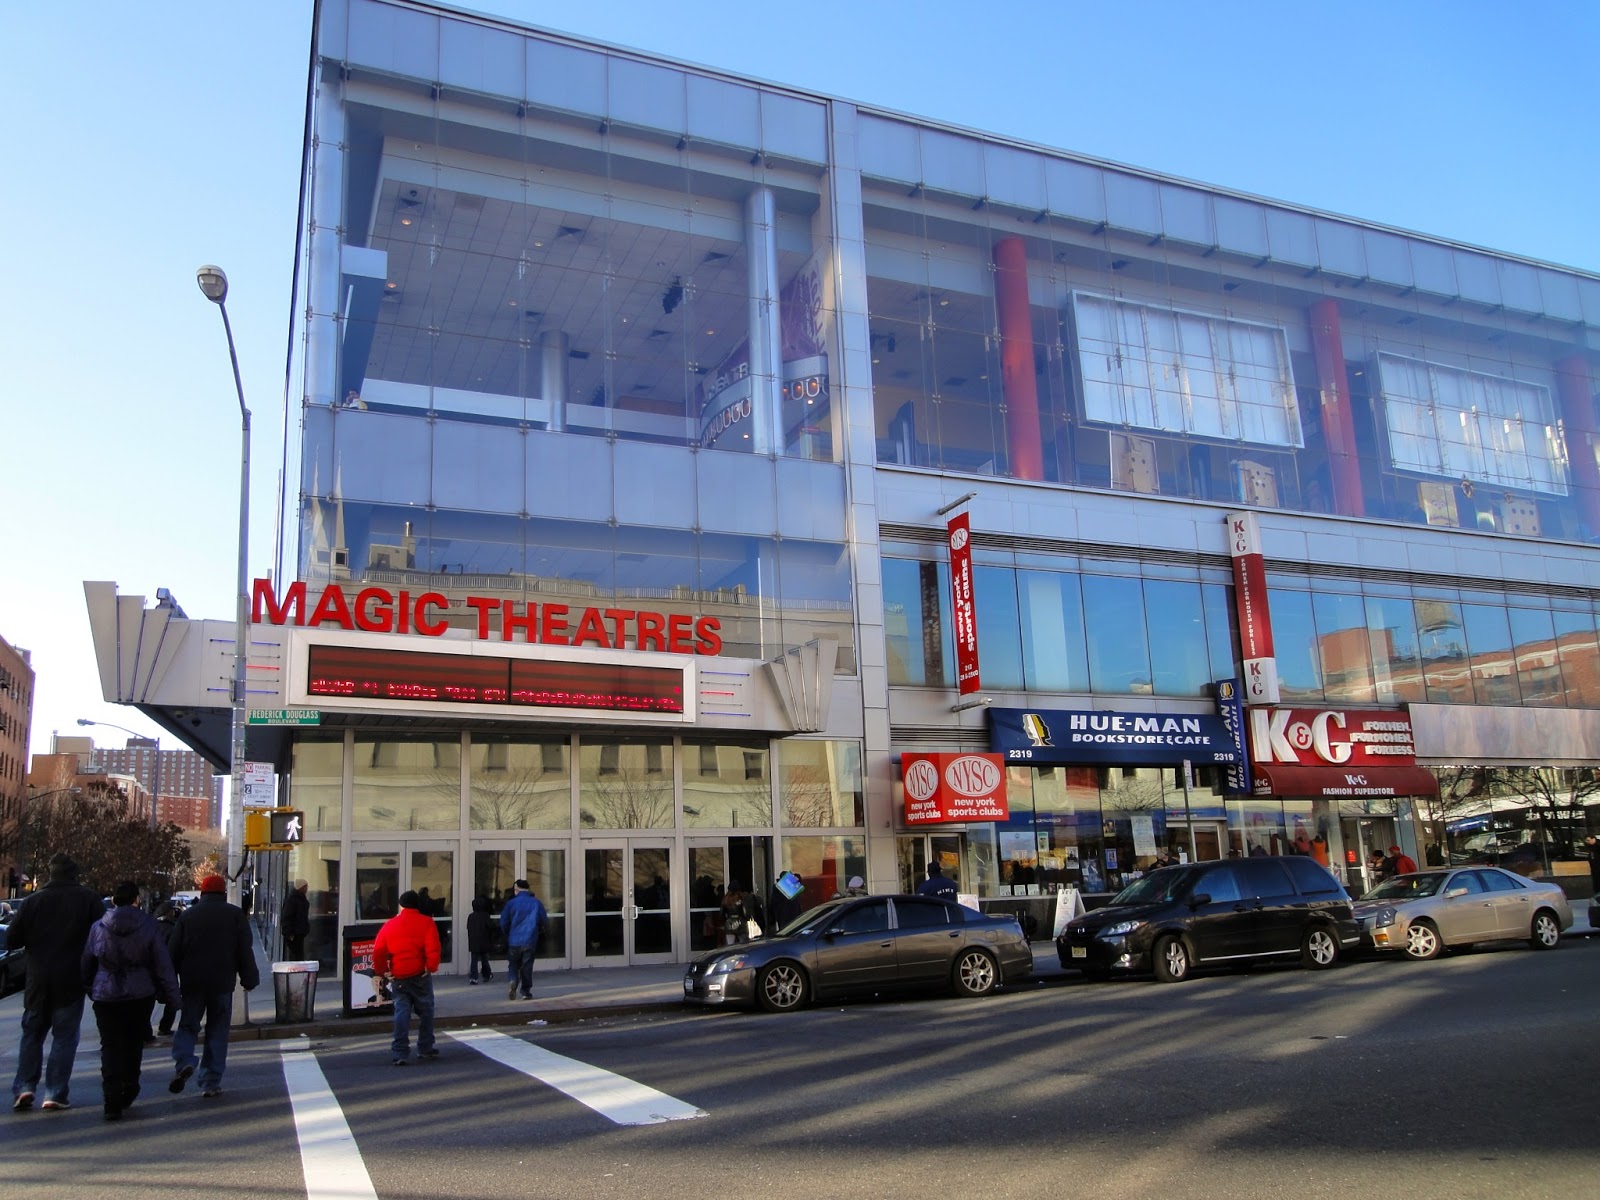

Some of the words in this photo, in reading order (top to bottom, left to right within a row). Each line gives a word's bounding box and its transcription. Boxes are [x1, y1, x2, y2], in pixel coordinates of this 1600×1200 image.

[252, 578, 449, 637] MAGIC
[466, 596, 722, 656] THEATRES
[963, 601, 975, 652] sports
[249, 710, 283, 719] FREDERICK
[286, 710, 319, 719] DOUGLASS
[1070, 714, 1201, 733] HUE-MAN
[1072, 733, 1165, 745] BOOKSTORE
[1173, 735, 1211, 745] CAFE
[1250, 708, 1354, 764] K&G
[1009, 749, 1032, 758] 2319
[1213, 753, 1234, 761] 2319
[245, 763, 253, 772] NO
[909, 764, 935, 796] NYSC
[953, 760, 994, 792] NYSC
[1322, 787, 1353, 795] FASHION
[1354, 787, 1395, 795] SUPERSTORE
[911, 802, 922, 810] new
[923, 800, 936, 811] york
[975, 797, 996, 807] york
[908, 811, 925, 821] sports
[925, 810, 941, 819] clubs
[948, 808, 977, 817] sports
[979, 807, 1003, 816] clubs
